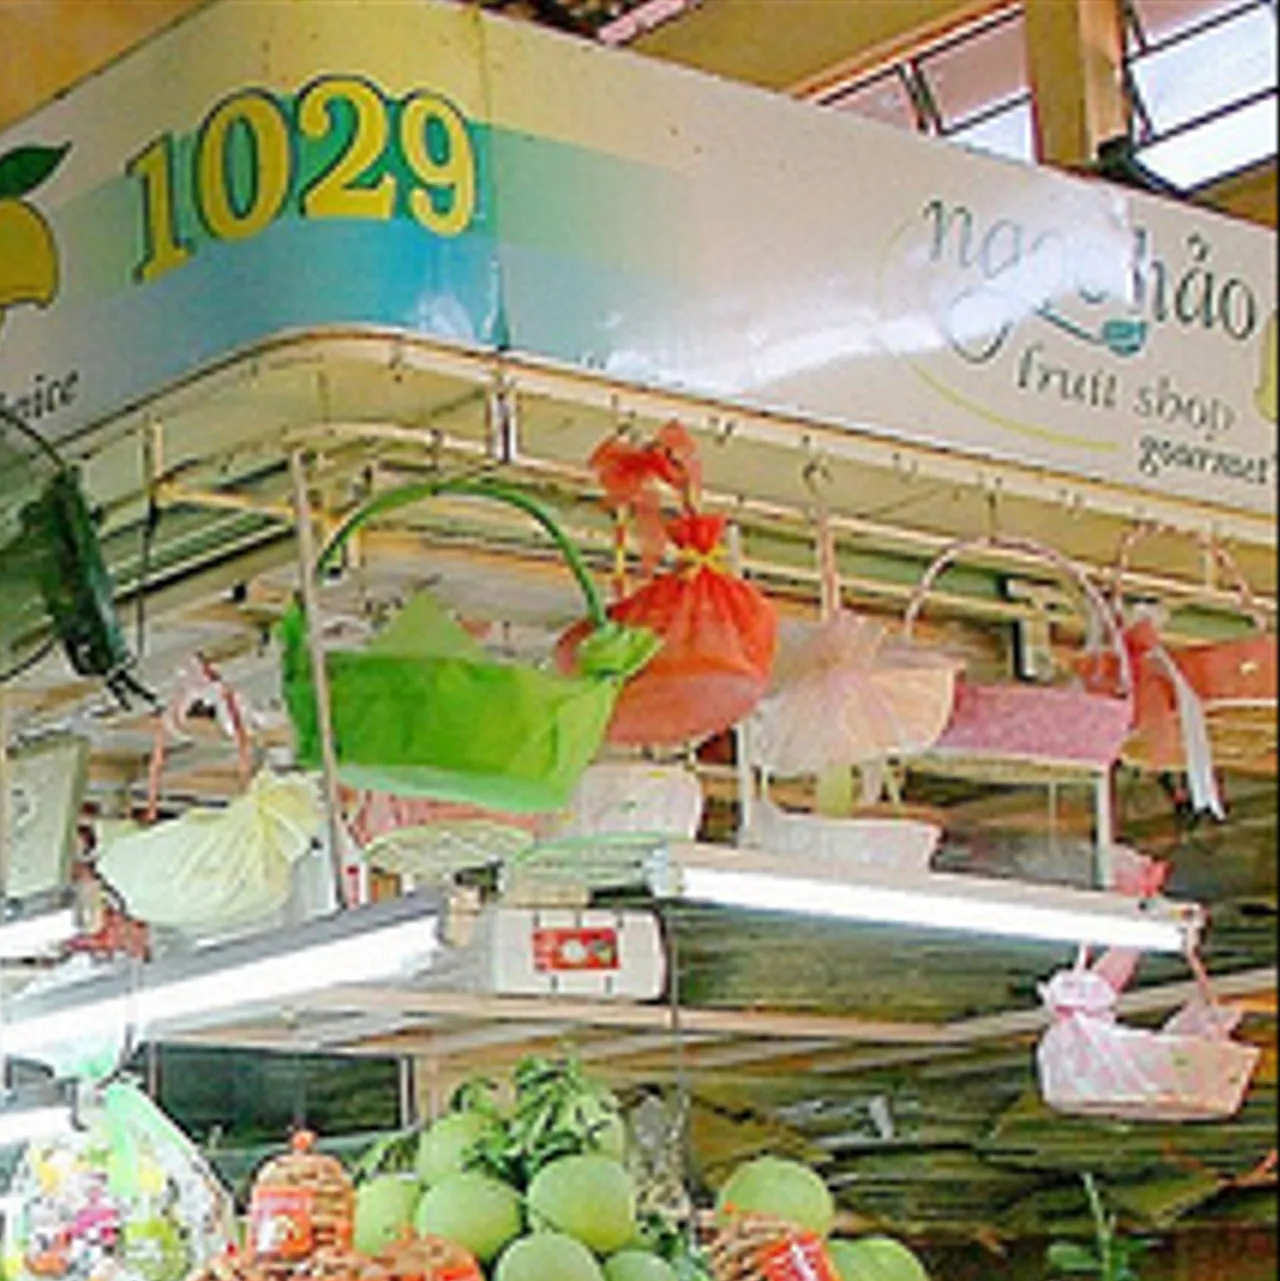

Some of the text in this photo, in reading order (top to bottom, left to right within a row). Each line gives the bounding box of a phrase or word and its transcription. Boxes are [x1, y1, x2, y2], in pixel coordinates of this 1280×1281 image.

[124, 73, 476, 284] 1029
[1016, 344, 1237, 443] fruit shop
